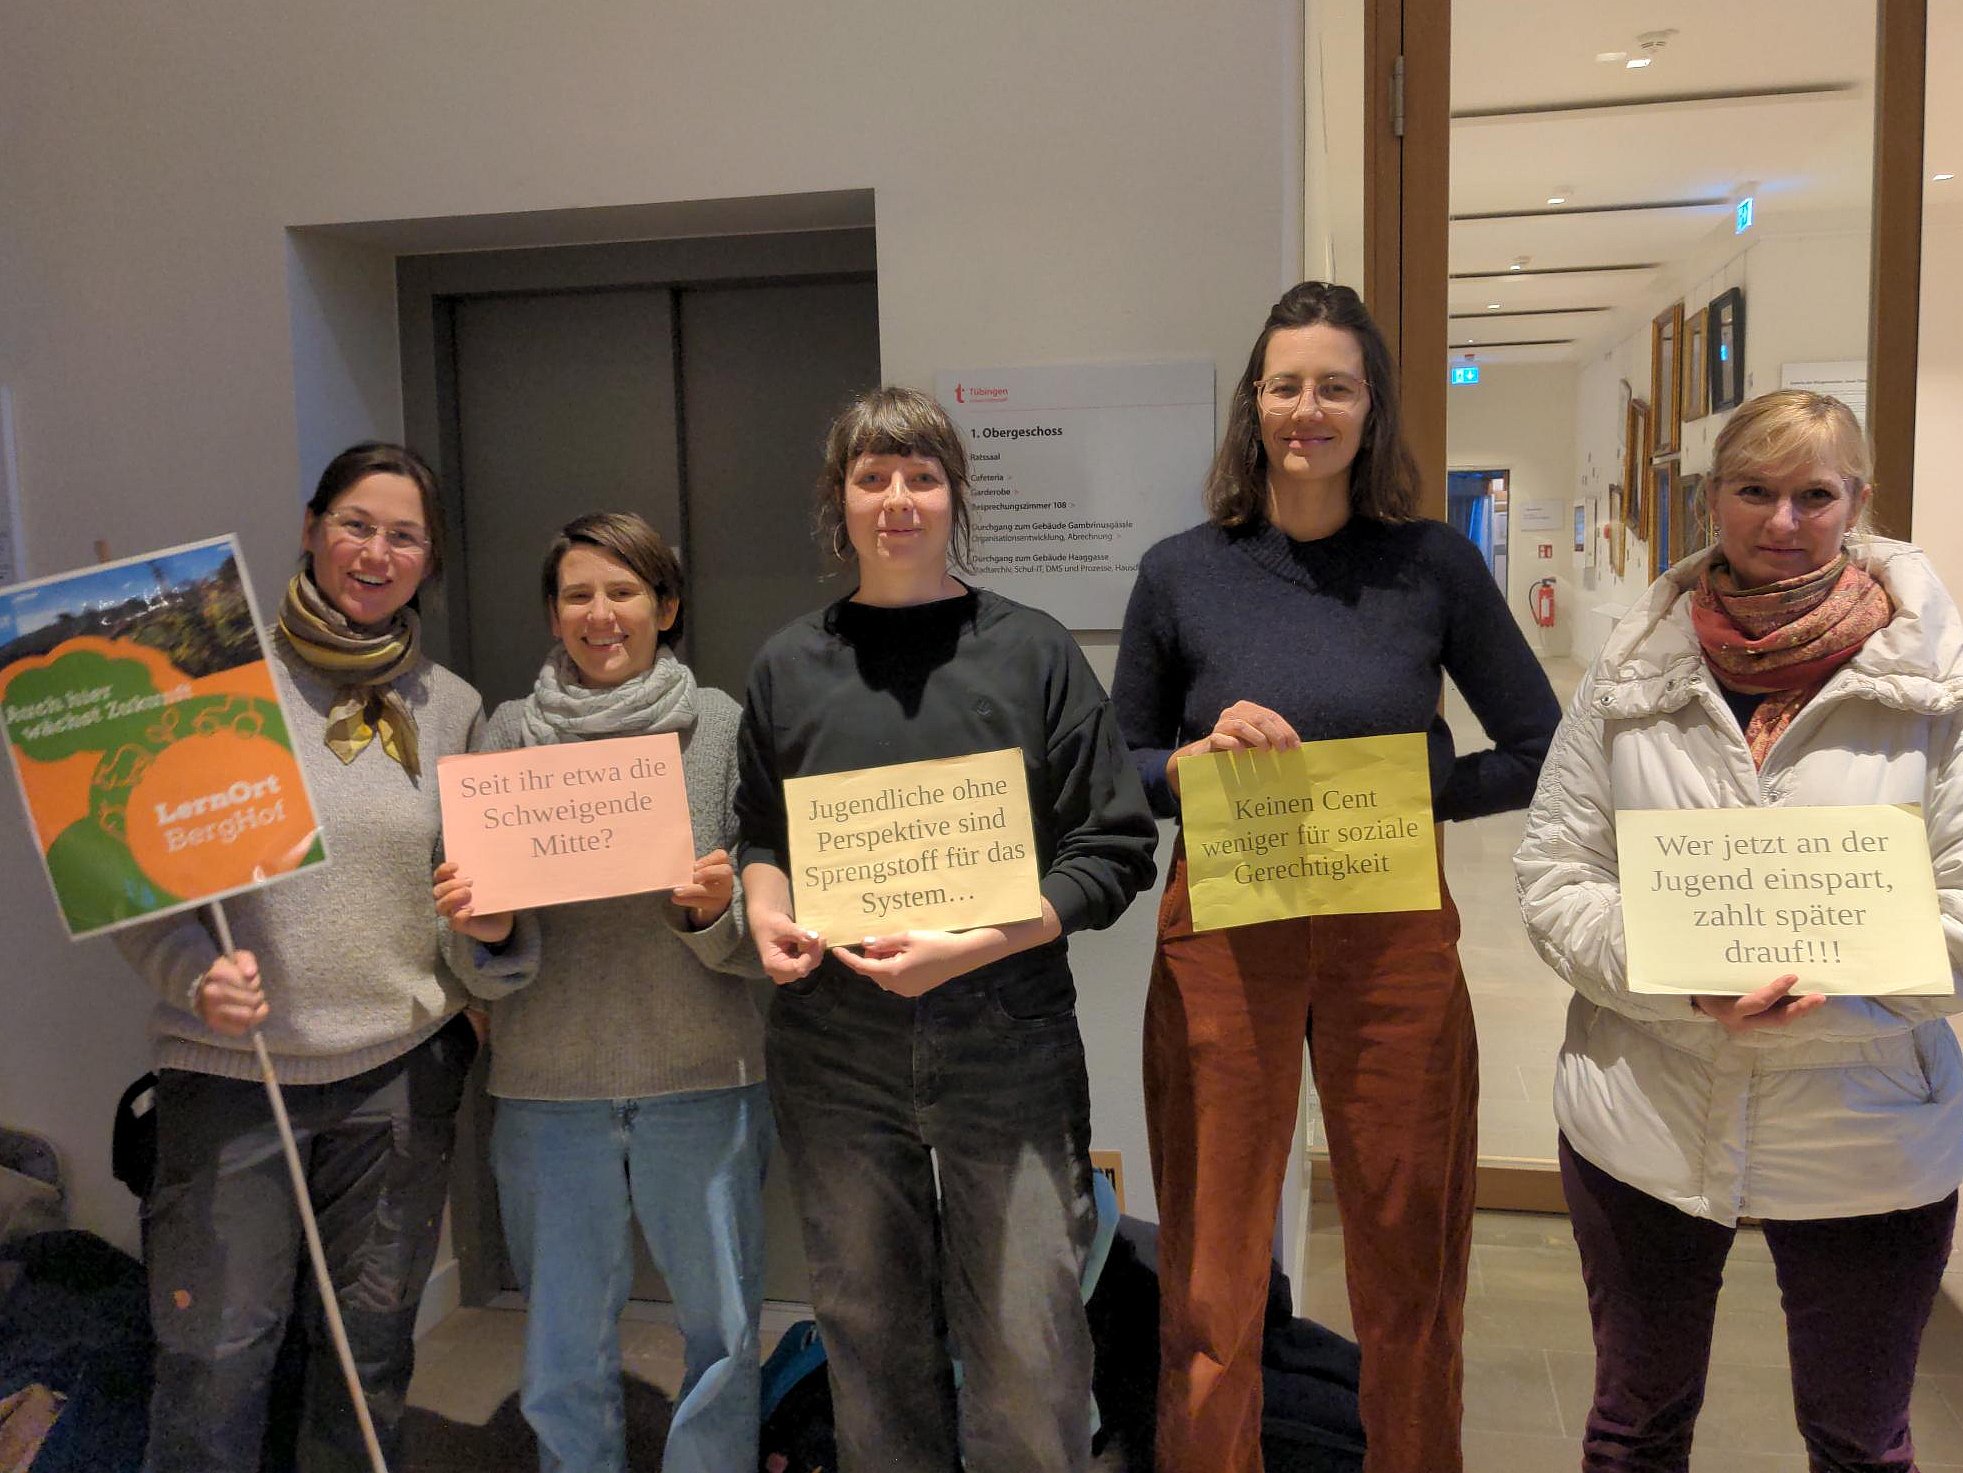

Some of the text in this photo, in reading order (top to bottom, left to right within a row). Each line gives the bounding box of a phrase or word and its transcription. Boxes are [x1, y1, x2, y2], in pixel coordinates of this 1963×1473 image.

[969, 387, 1008, 397] Tübingen
[971, 426, 1063, 440] 1. Obergeschoss
[970, 473, 1004, 481] Cafeteria
[1053, 501, 1067, 509] 108
[1032, 522, 1067, 530] Gebäude
[1068, 532, 1113, 541] Abrechnung
[1065, 564, 1079, 572] und
[461, 758, 667, 798] Seit ihr etwa die
[155, 775, 281, 826] LernOrt
[483, 791, 653, 829] Schweigende
[808, 779, 1008, 822] Jugendliche ohne
[1234, 789, 1378, 820] Keinen Cent
[164, 798, 286, 854] BergHof
[817, 807, 1007, 852] Perspektive sind
[1201, 817, 1419, 858] weniger für soziale
[531, 828, 613, 858] Mitte?
[1654, 830, 1889, 861] Wer jetzt an der
[805, 841, 1026, 891] Sprengstoff für das
[1234, 853, 1390, 885] Gerechtigkeit
[1651, 868, 1893, 897] Jugend einspart,
[861, 887, 974, 918] System...
[1693, 903, 1866, 932] zahlt später
[1724, 939, 1841, 964] drauf!!!
